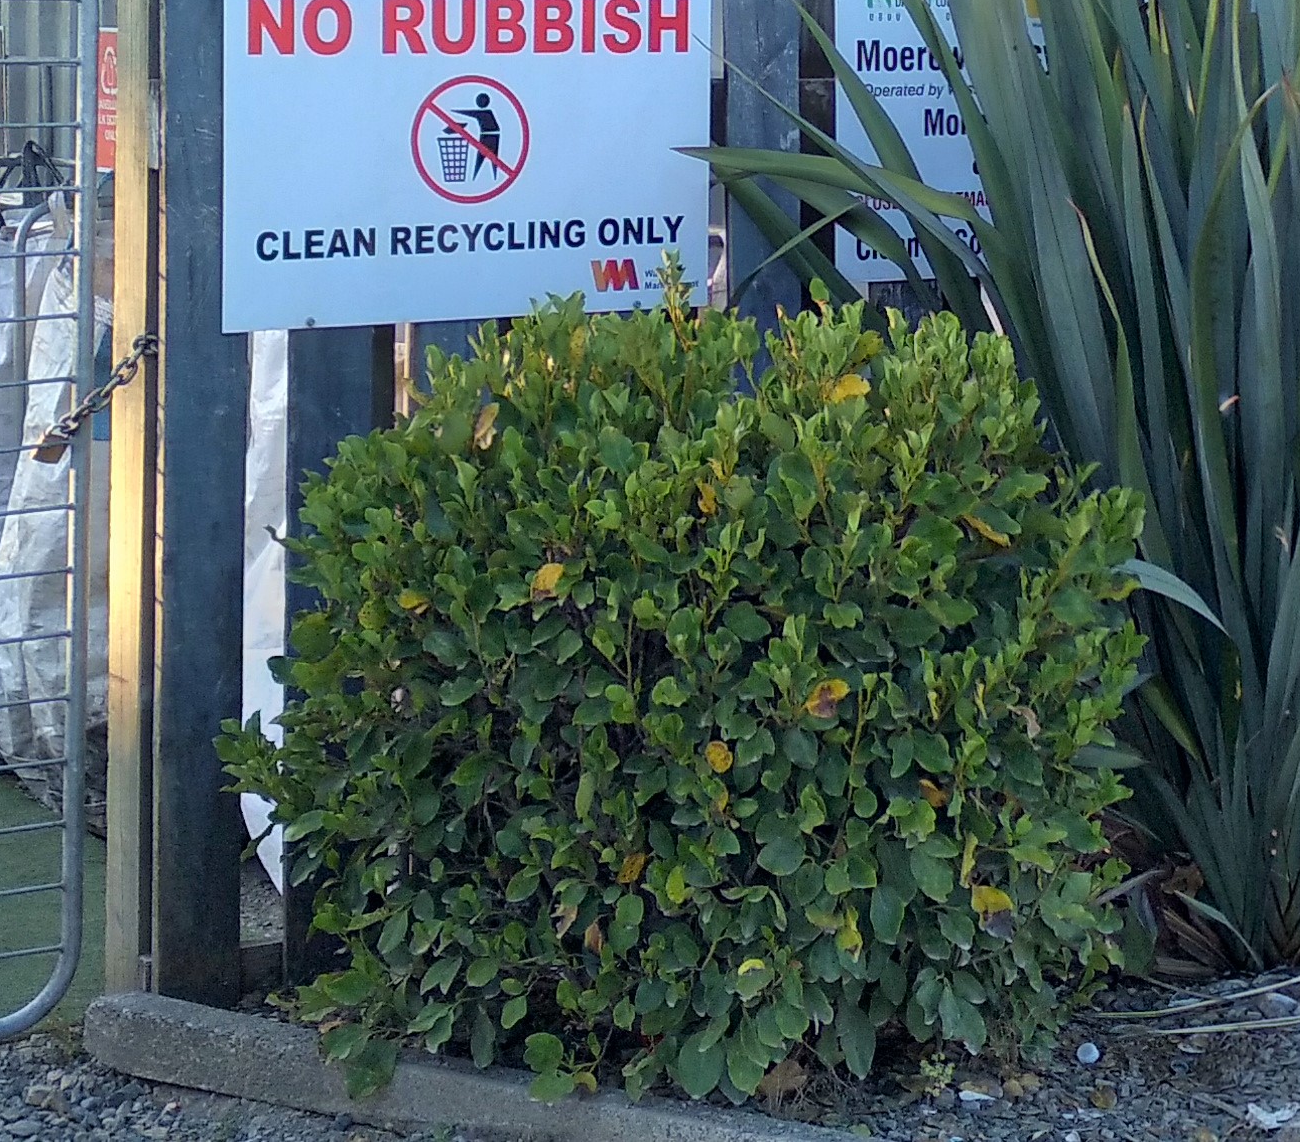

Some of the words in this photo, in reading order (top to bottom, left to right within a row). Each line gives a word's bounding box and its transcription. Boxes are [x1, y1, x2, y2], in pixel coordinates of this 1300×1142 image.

[865, 84, 925, 98] Operated
[928, 84, 944, 99] by
[256, 227, 377, 262] CLEAN
[390, 219, 586, 256] RECYCLING
[598, 215, 685, 246] ONLY
